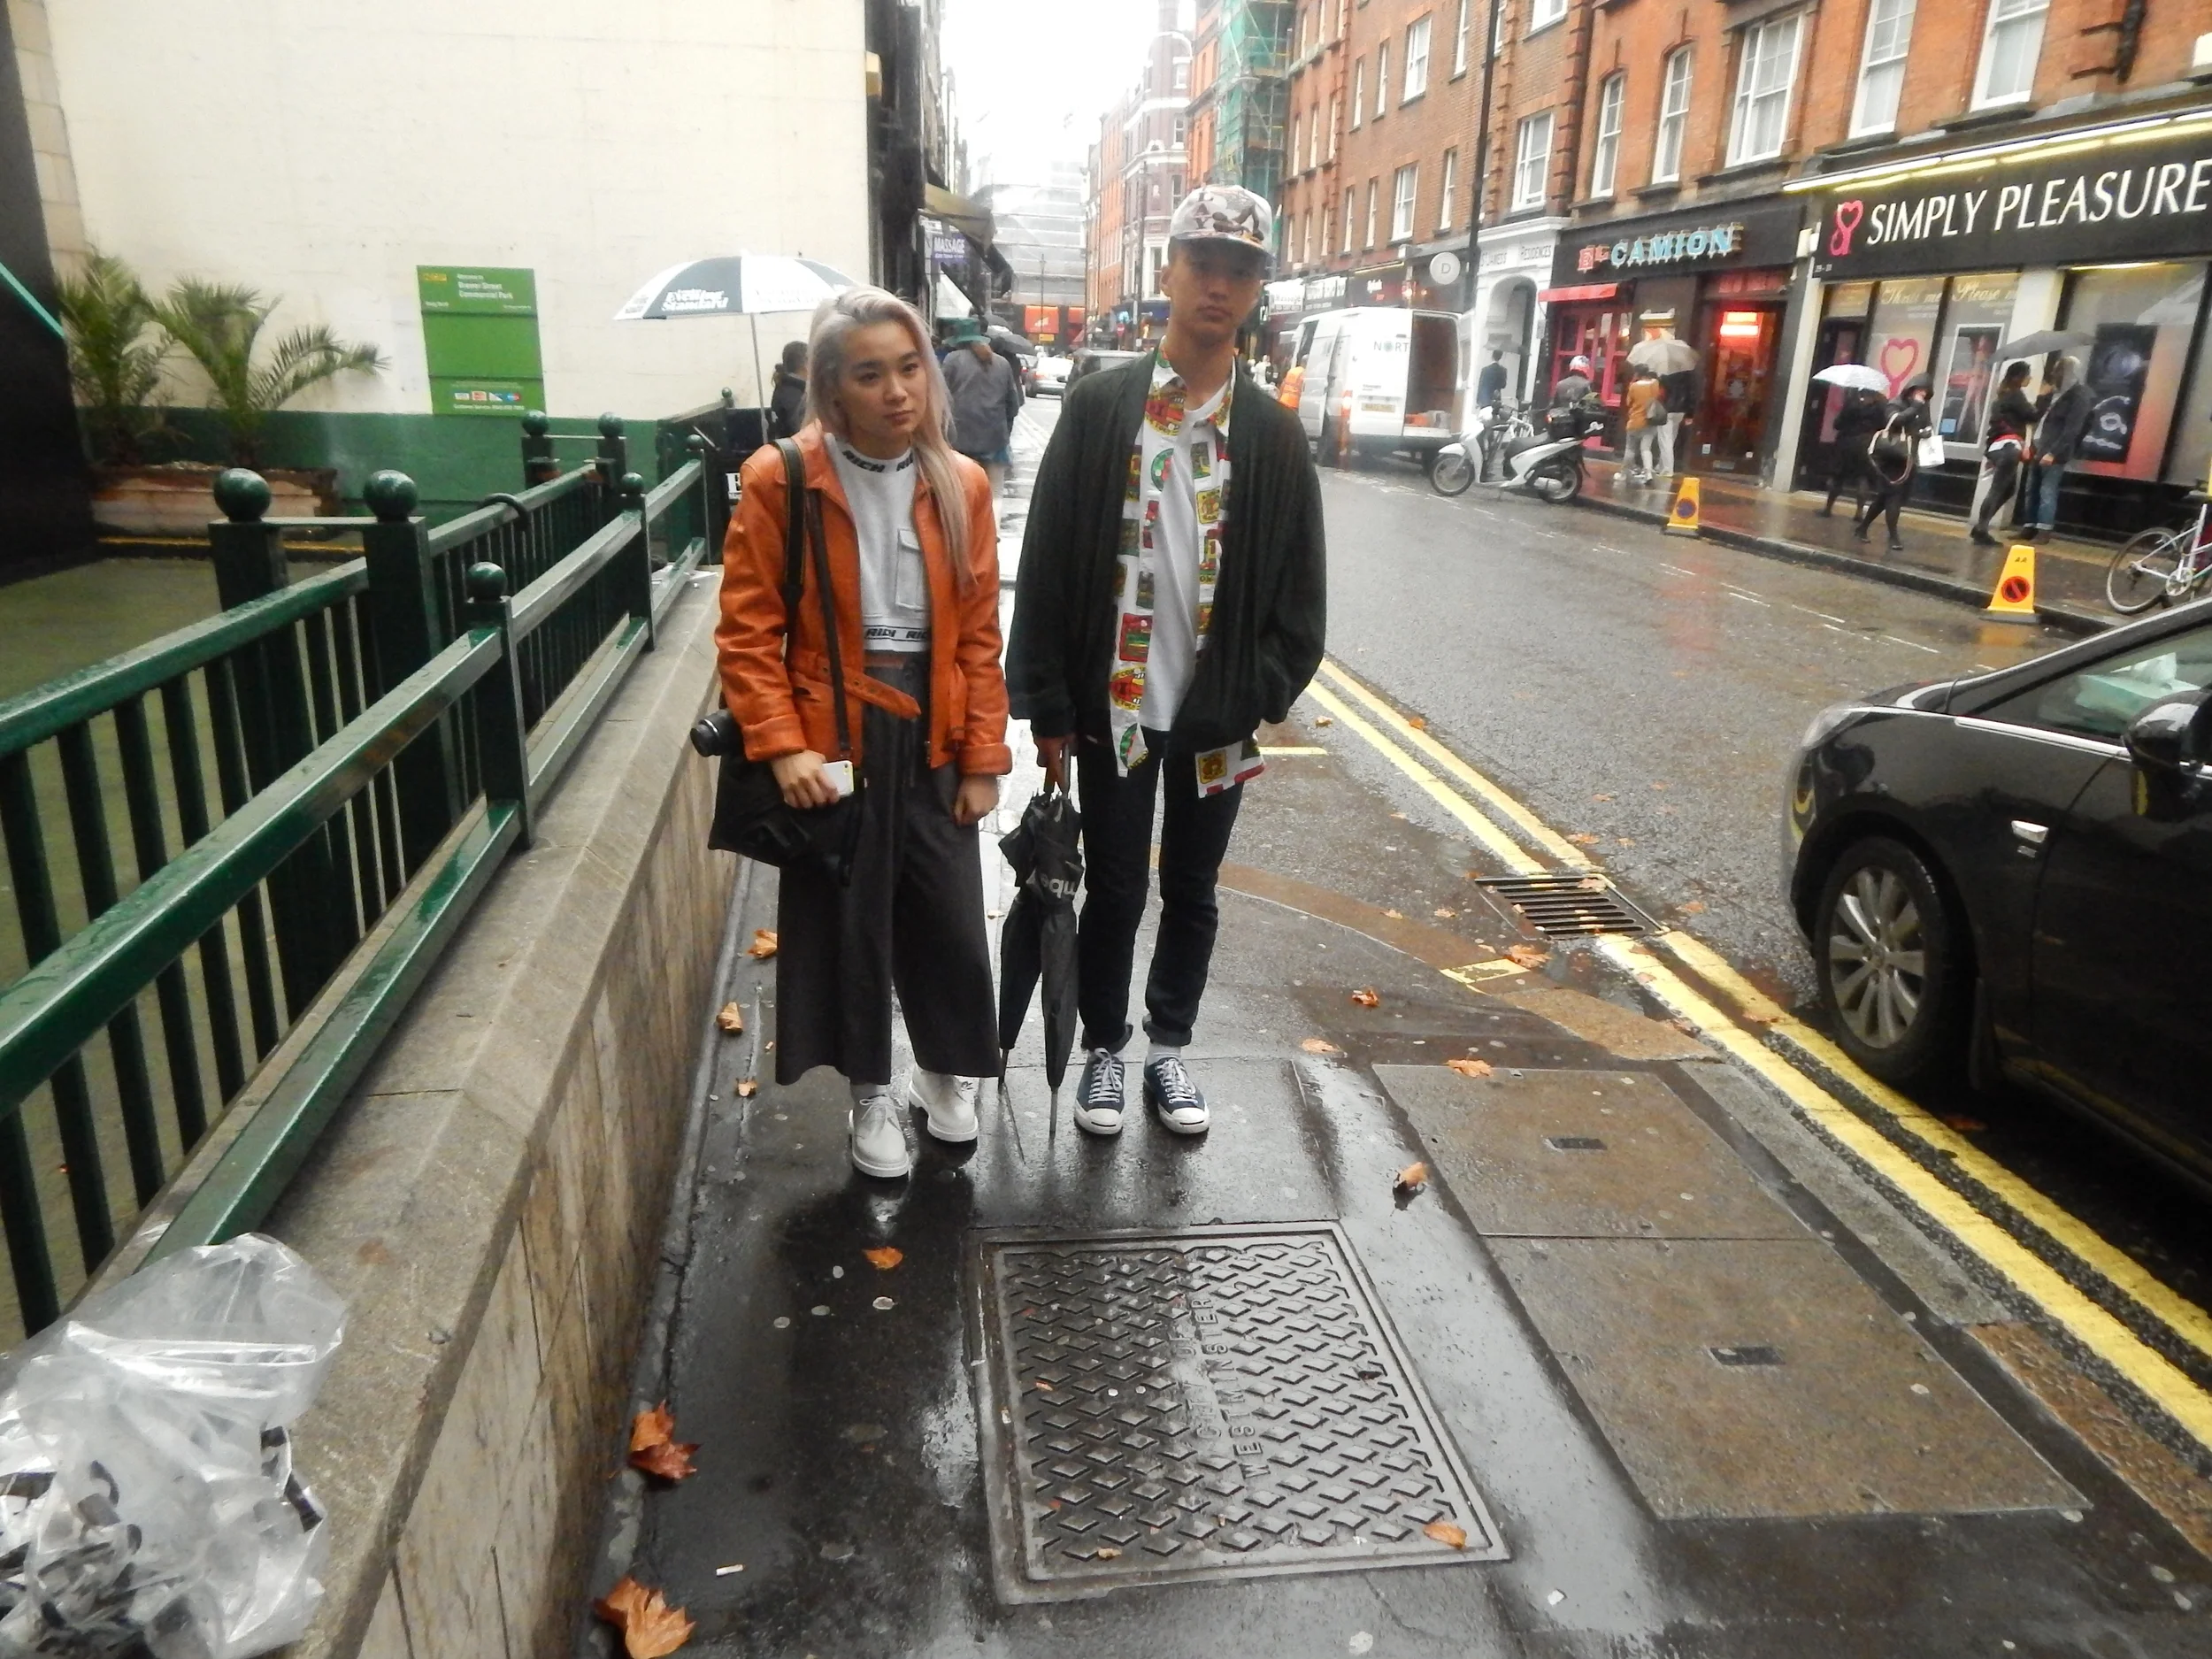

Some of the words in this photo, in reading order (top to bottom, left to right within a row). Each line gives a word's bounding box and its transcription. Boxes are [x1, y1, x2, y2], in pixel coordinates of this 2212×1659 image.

[1866, 188, 1988, 246] SIMPLY
[1993, 159, 2212, 232] PLEASURE
[933, 237, 965, 254] MASSAGE
[1578, 245, 1609, 272] EL
[1610, 223, 1742, 269] CAMION
[1440, 263, 1451, 274] D
[842, 449, 885, 473] RICH
[1191, 1297, 1271, 1481] WESTMINSTER
